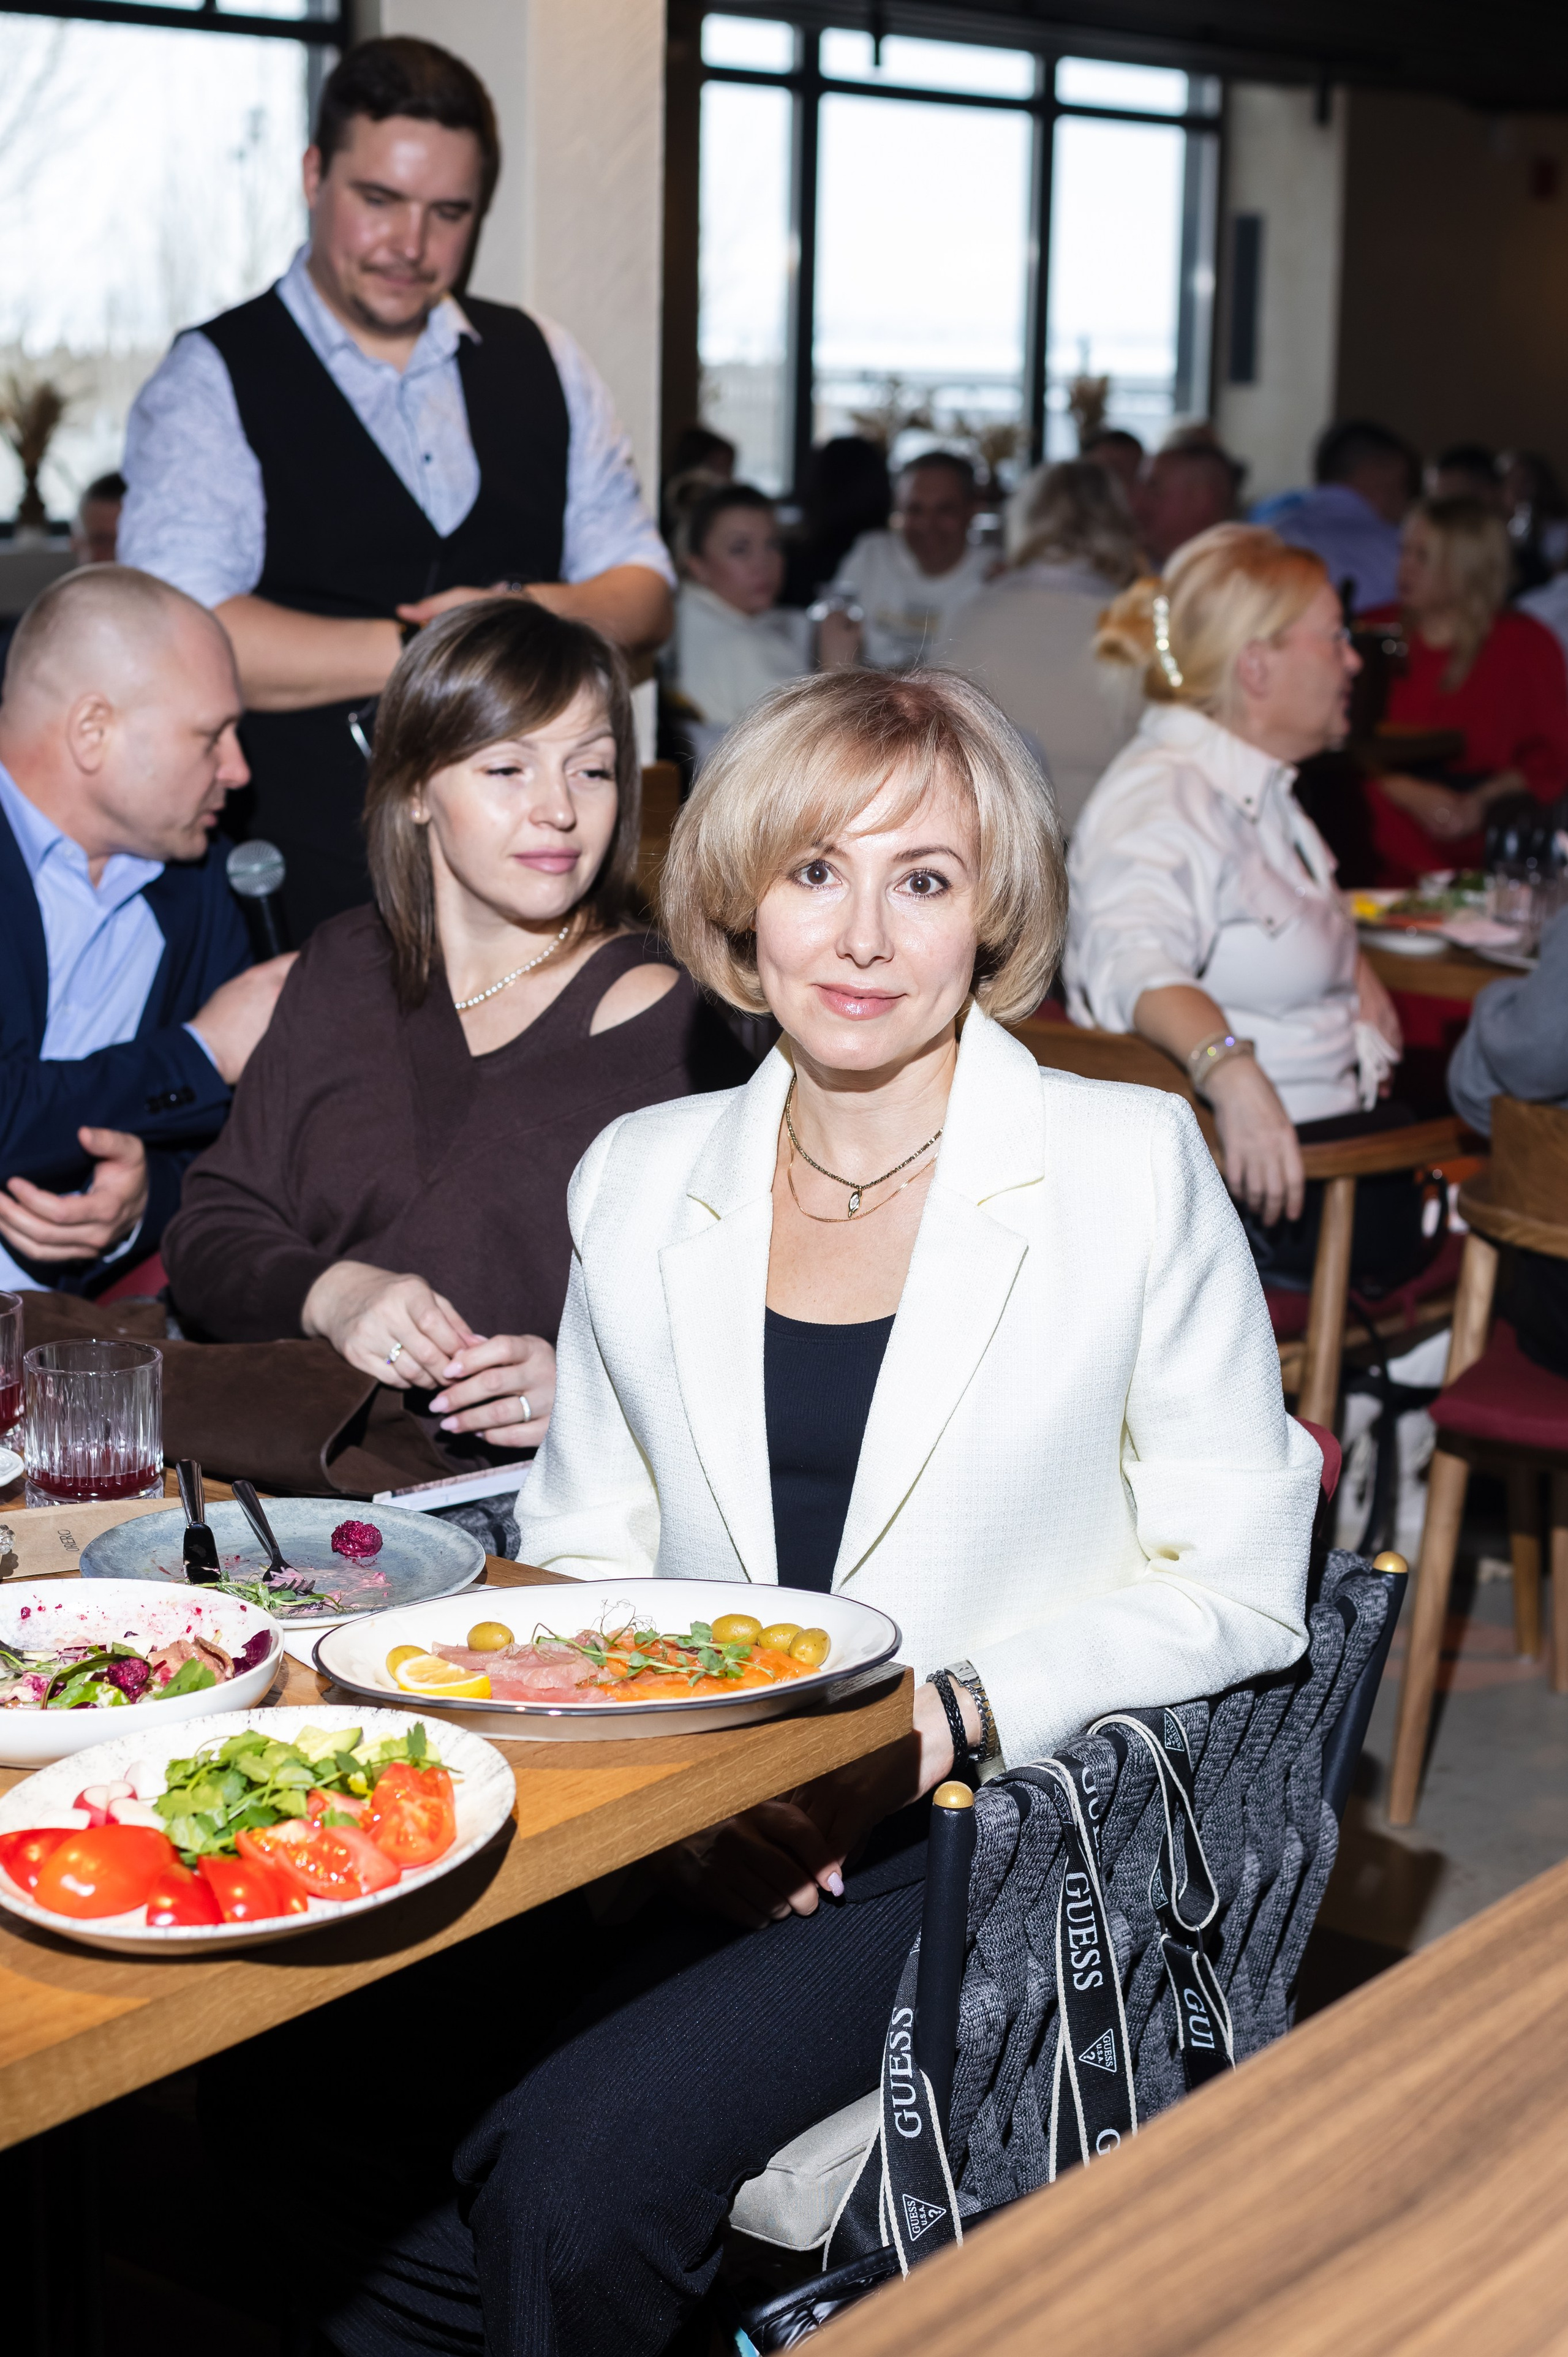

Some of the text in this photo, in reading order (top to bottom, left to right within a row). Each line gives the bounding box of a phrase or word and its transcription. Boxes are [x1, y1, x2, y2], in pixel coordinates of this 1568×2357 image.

[1066, 1872, 1104, 1991] GUESS
[1103, 2035, 1114, 2067] GUESS
[889, 2007, 922, 2138] GUESS
[907, 2200, 921, 2234] GUESS
[919, 2205, 928, 2226] U.S.A.
